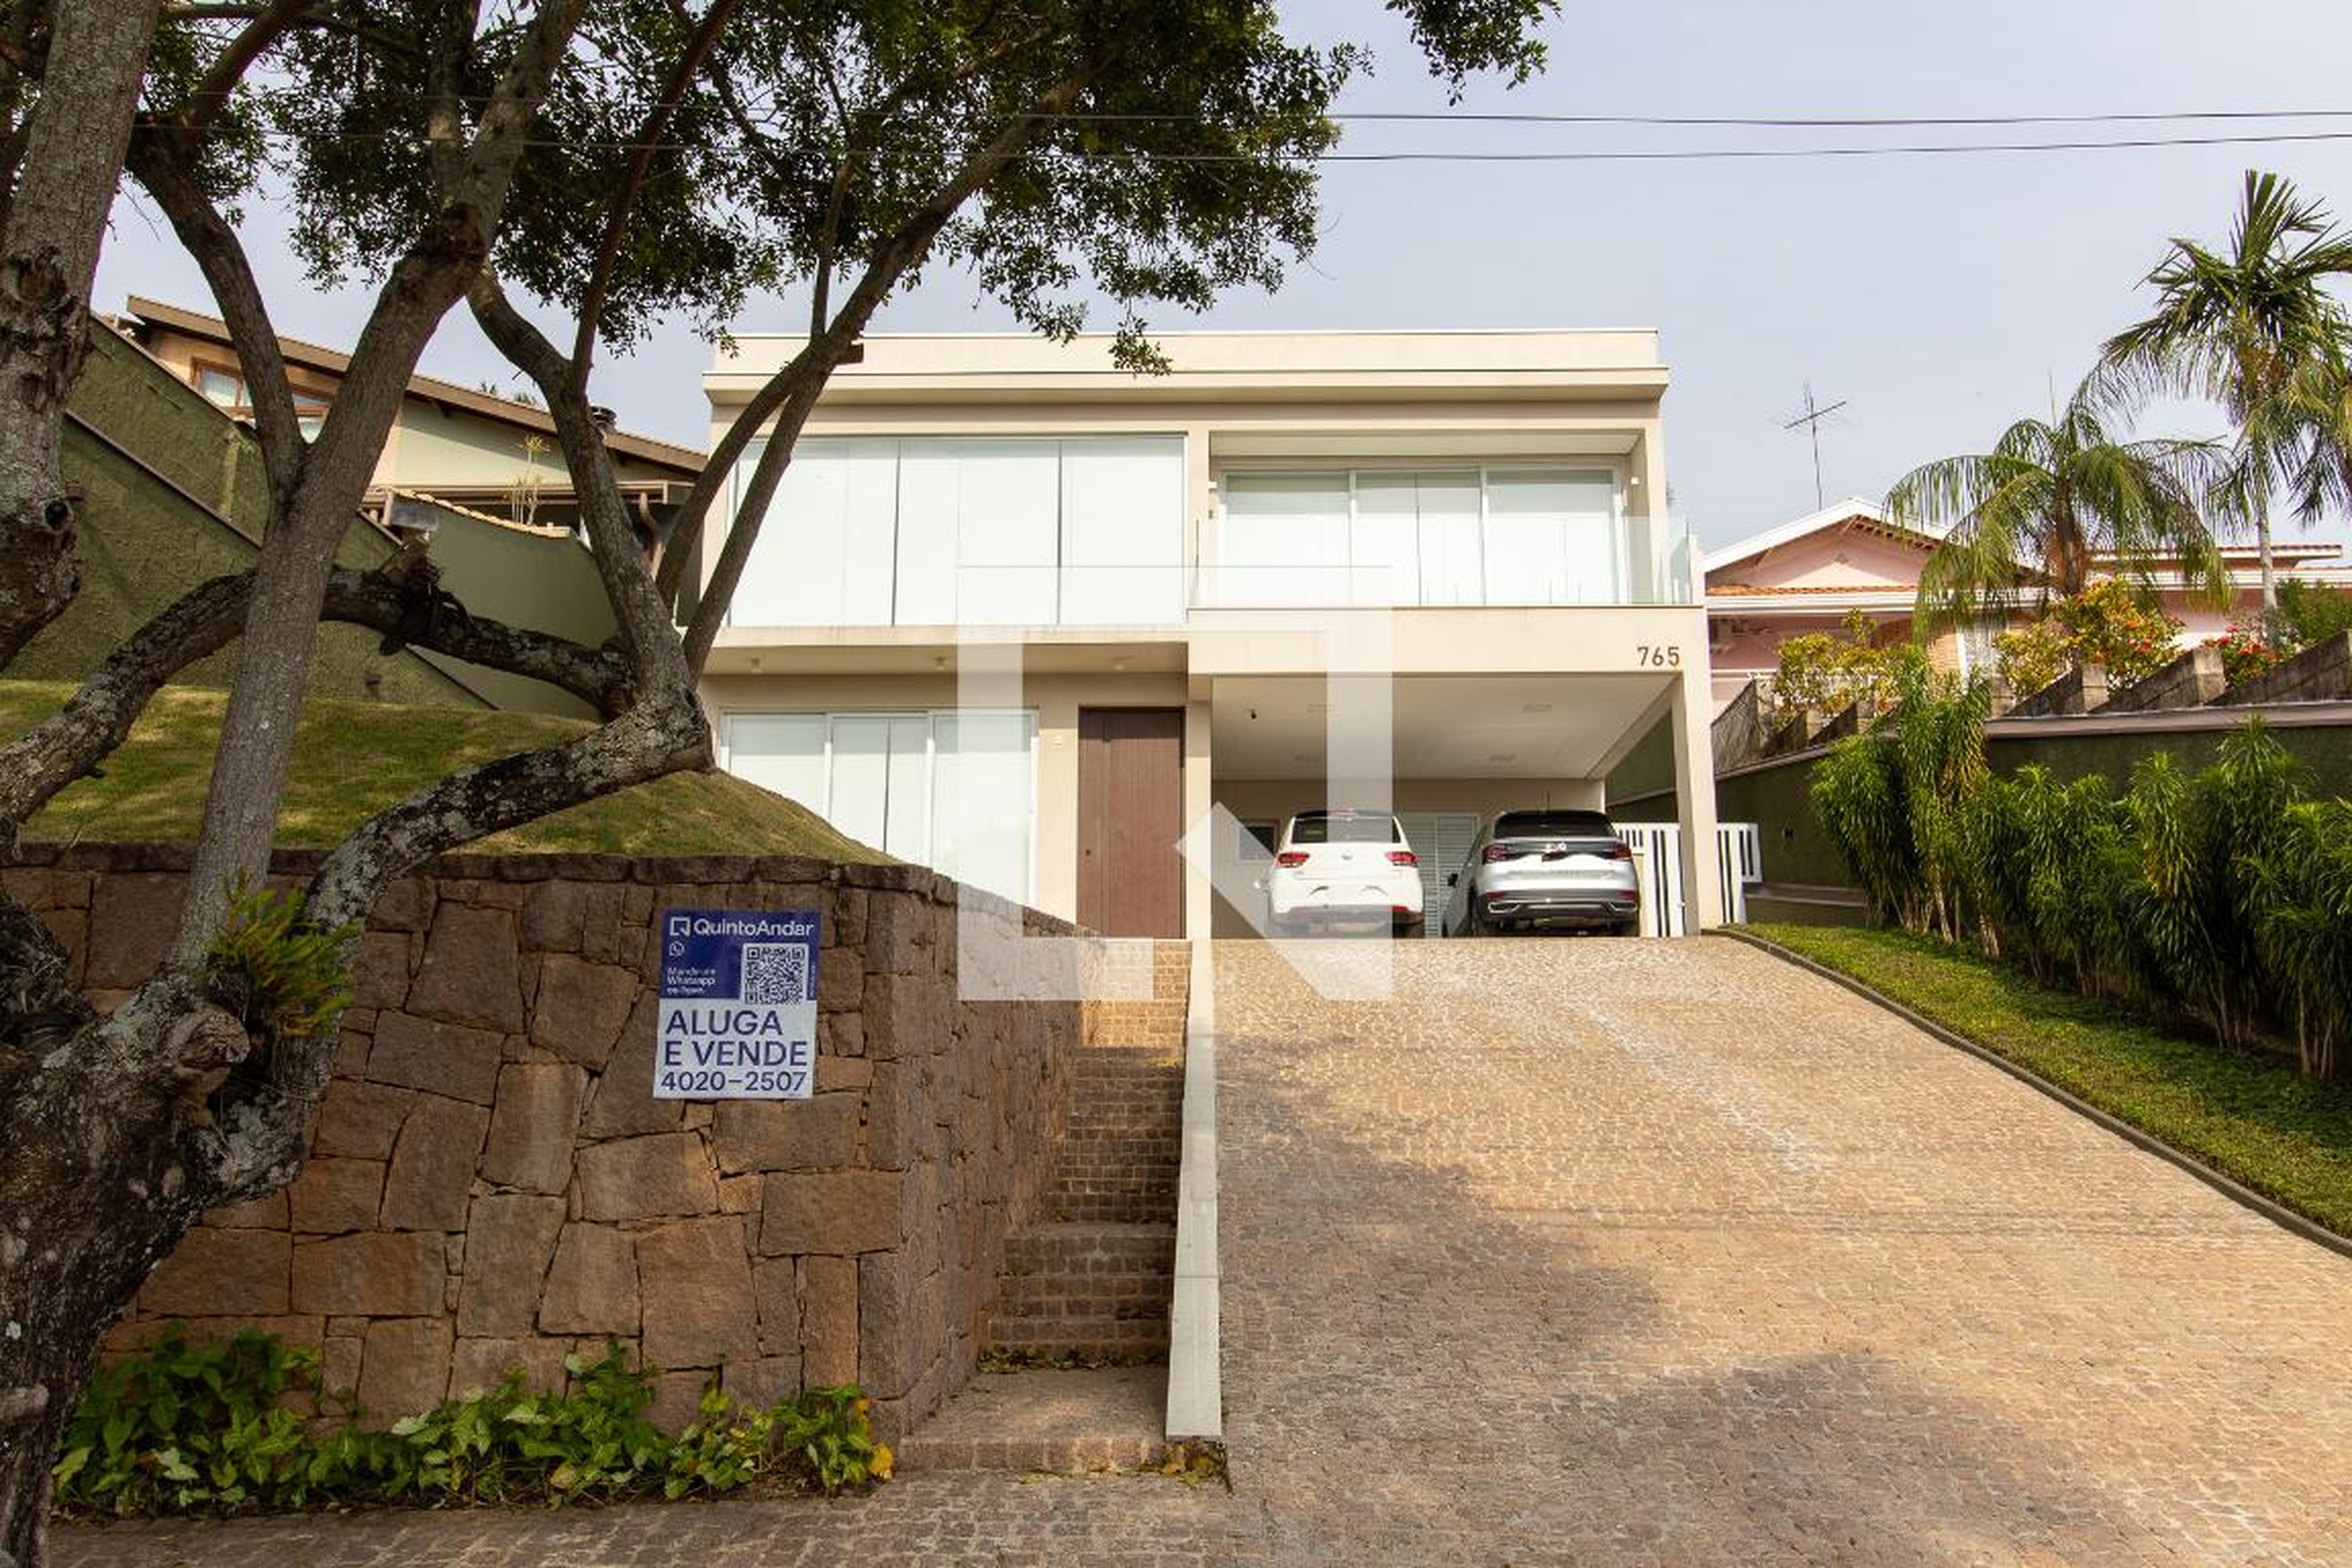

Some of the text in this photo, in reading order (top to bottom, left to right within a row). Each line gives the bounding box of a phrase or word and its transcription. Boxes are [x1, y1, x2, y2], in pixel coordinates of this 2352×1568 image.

[1637, 646, 1679, 666] 765
[693, 918, 815, 937] QuintoAndar
[665, 1009, 783, 1036] ALUGA
[665, 1041, 807, 1066] E VENDE
[661, 1071, 807, 1091] 4020-2507
